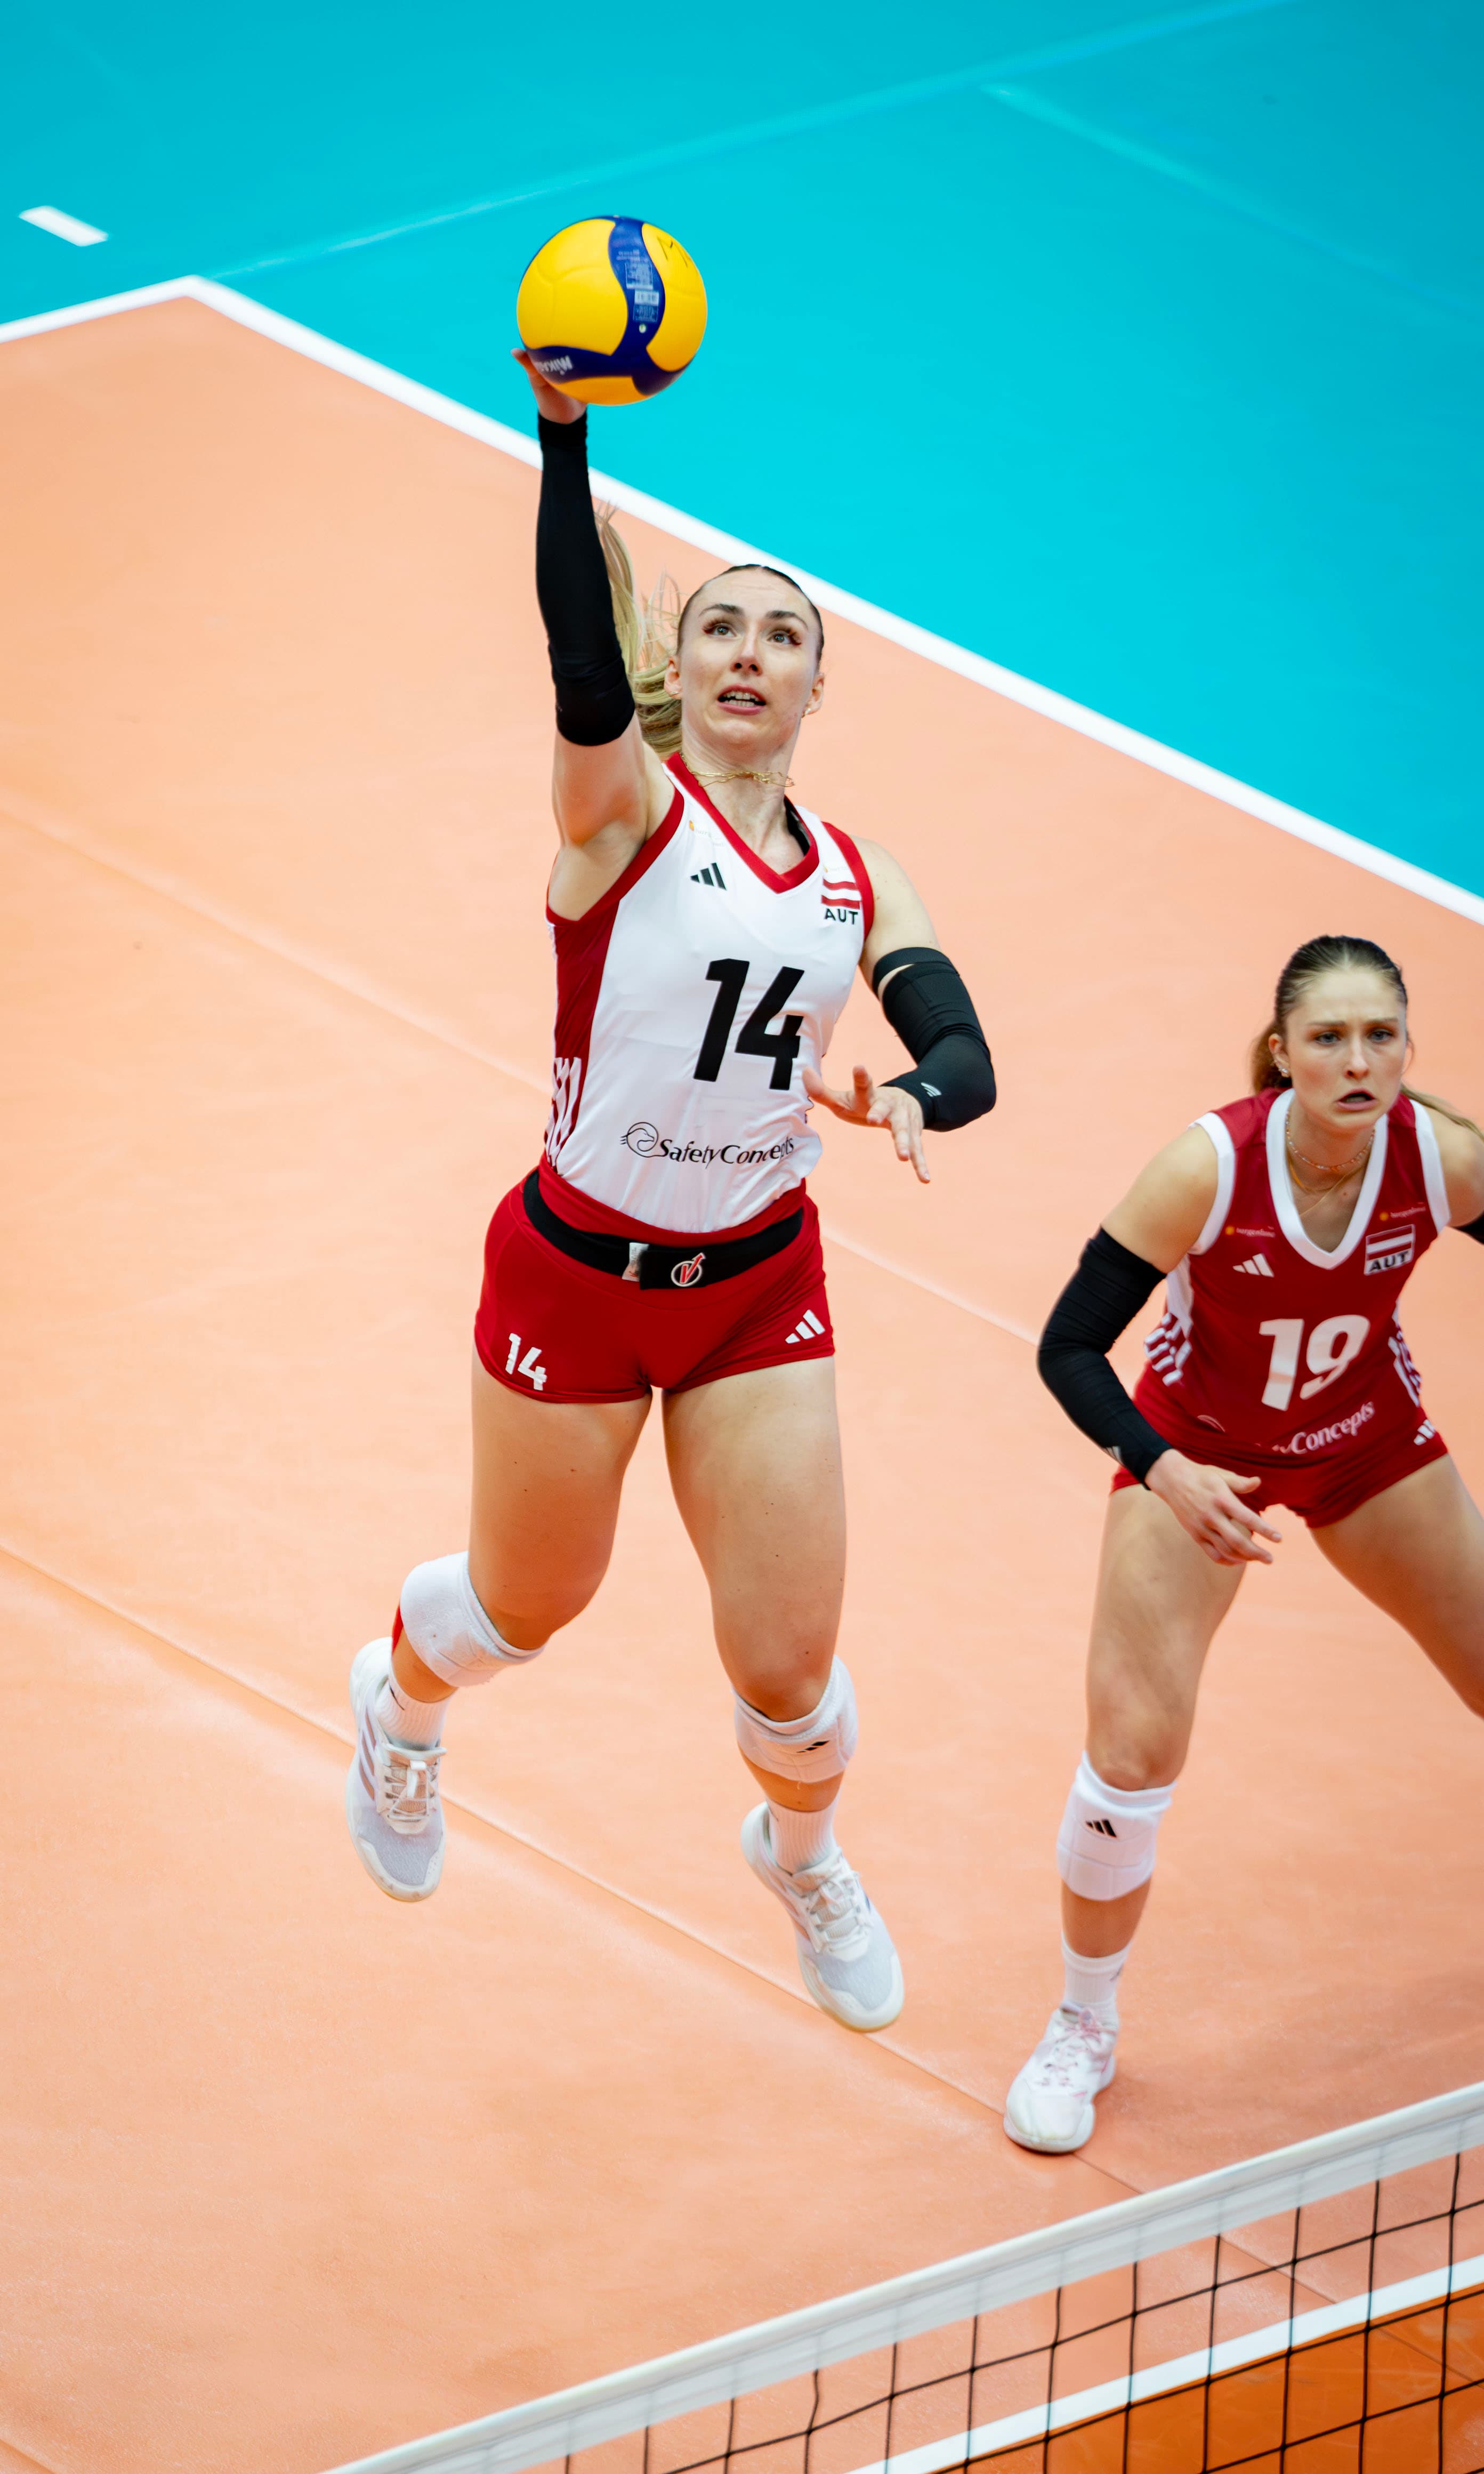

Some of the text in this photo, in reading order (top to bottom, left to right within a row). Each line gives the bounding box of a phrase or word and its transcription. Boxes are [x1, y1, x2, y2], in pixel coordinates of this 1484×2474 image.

[824, 908, 858, 925] AUT
[693, 958, 805, 1090] 14
[1368, 1250, 1409, 1272] AUT
[505, 1333, 547, 1391] 14
[1259, 1314, 1370, 1411] 19
[1271, 1401, 1375, 1455] Concepts
